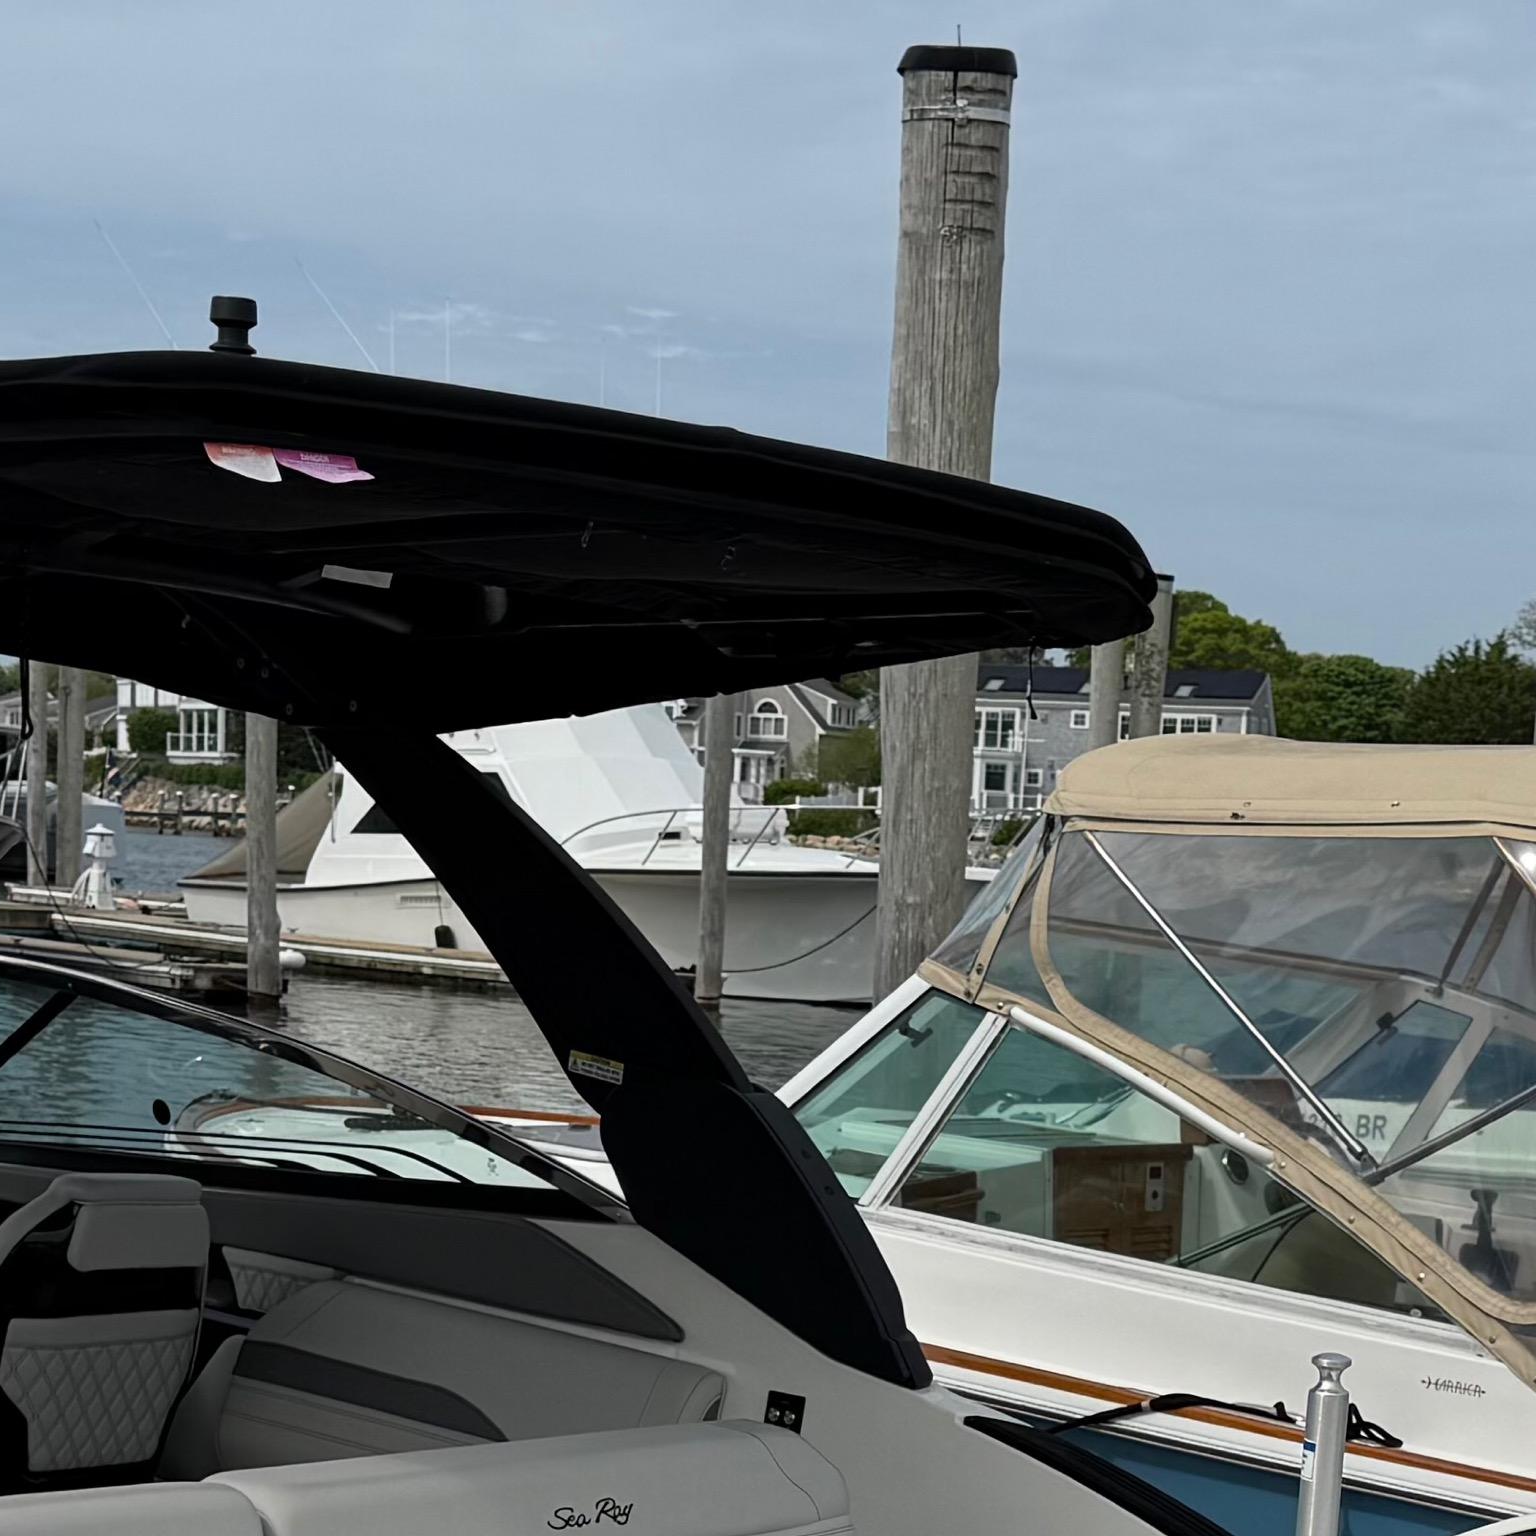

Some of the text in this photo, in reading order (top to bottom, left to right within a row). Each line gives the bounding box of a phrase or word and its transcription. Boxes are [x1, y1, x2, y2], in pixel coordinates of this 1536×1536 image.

[1355, 1114, 1388, 1140] BR
[547, 1497, 634, 1530] Sea Ray
